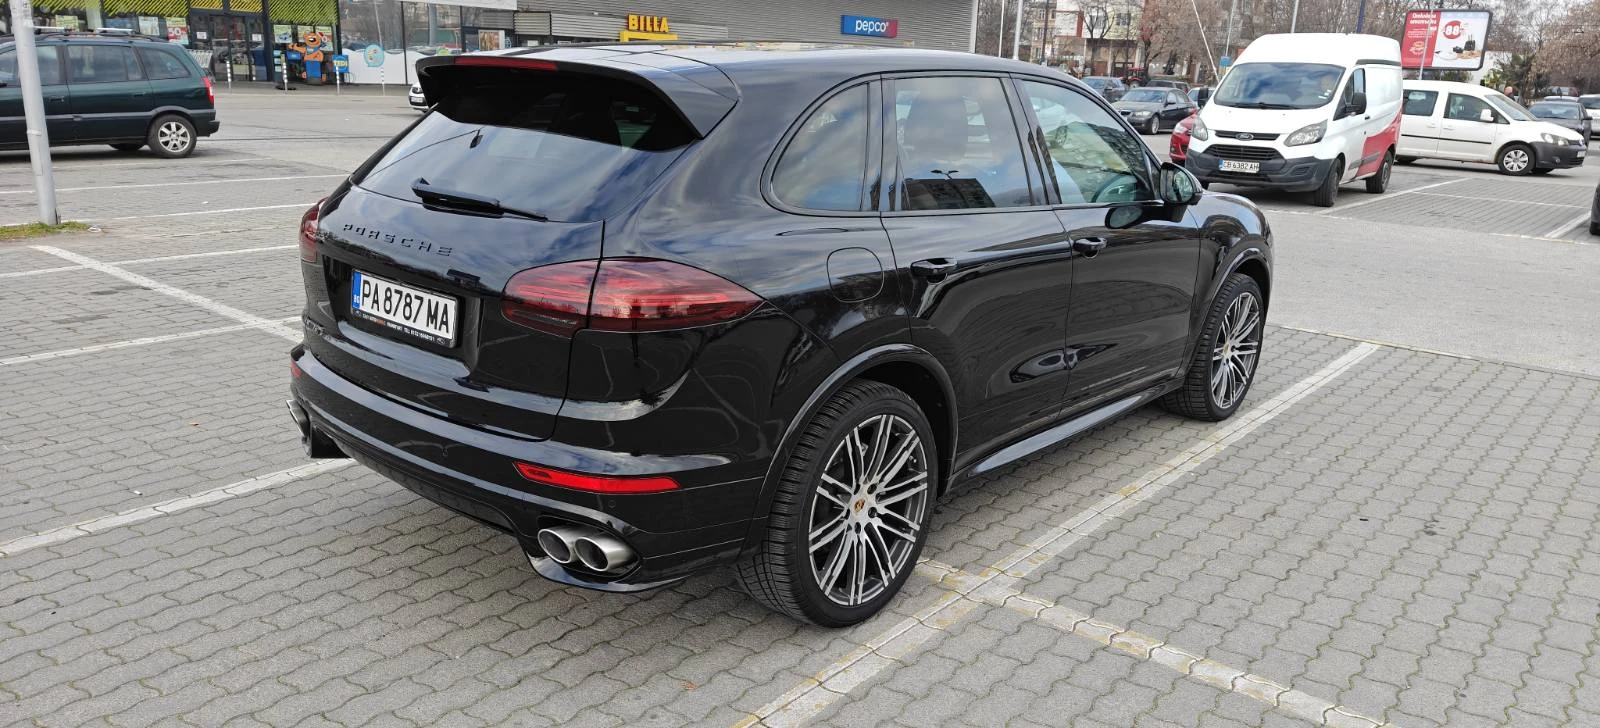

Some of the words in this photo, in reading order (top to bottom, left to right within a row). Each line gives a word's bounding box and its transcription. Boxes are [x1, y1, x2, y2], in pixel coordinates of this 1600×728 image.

[628, 14, 669, 32] BILLA
[855, 20, 887, 34] pepco
[1232, 162, 1248, 170] 6382
[342, 224, 453, 257] PORSCHE
[362, 280, 380, 311] PA
[383, 287, 424, 323] 8787
[426, 299, 449, 333] MA
